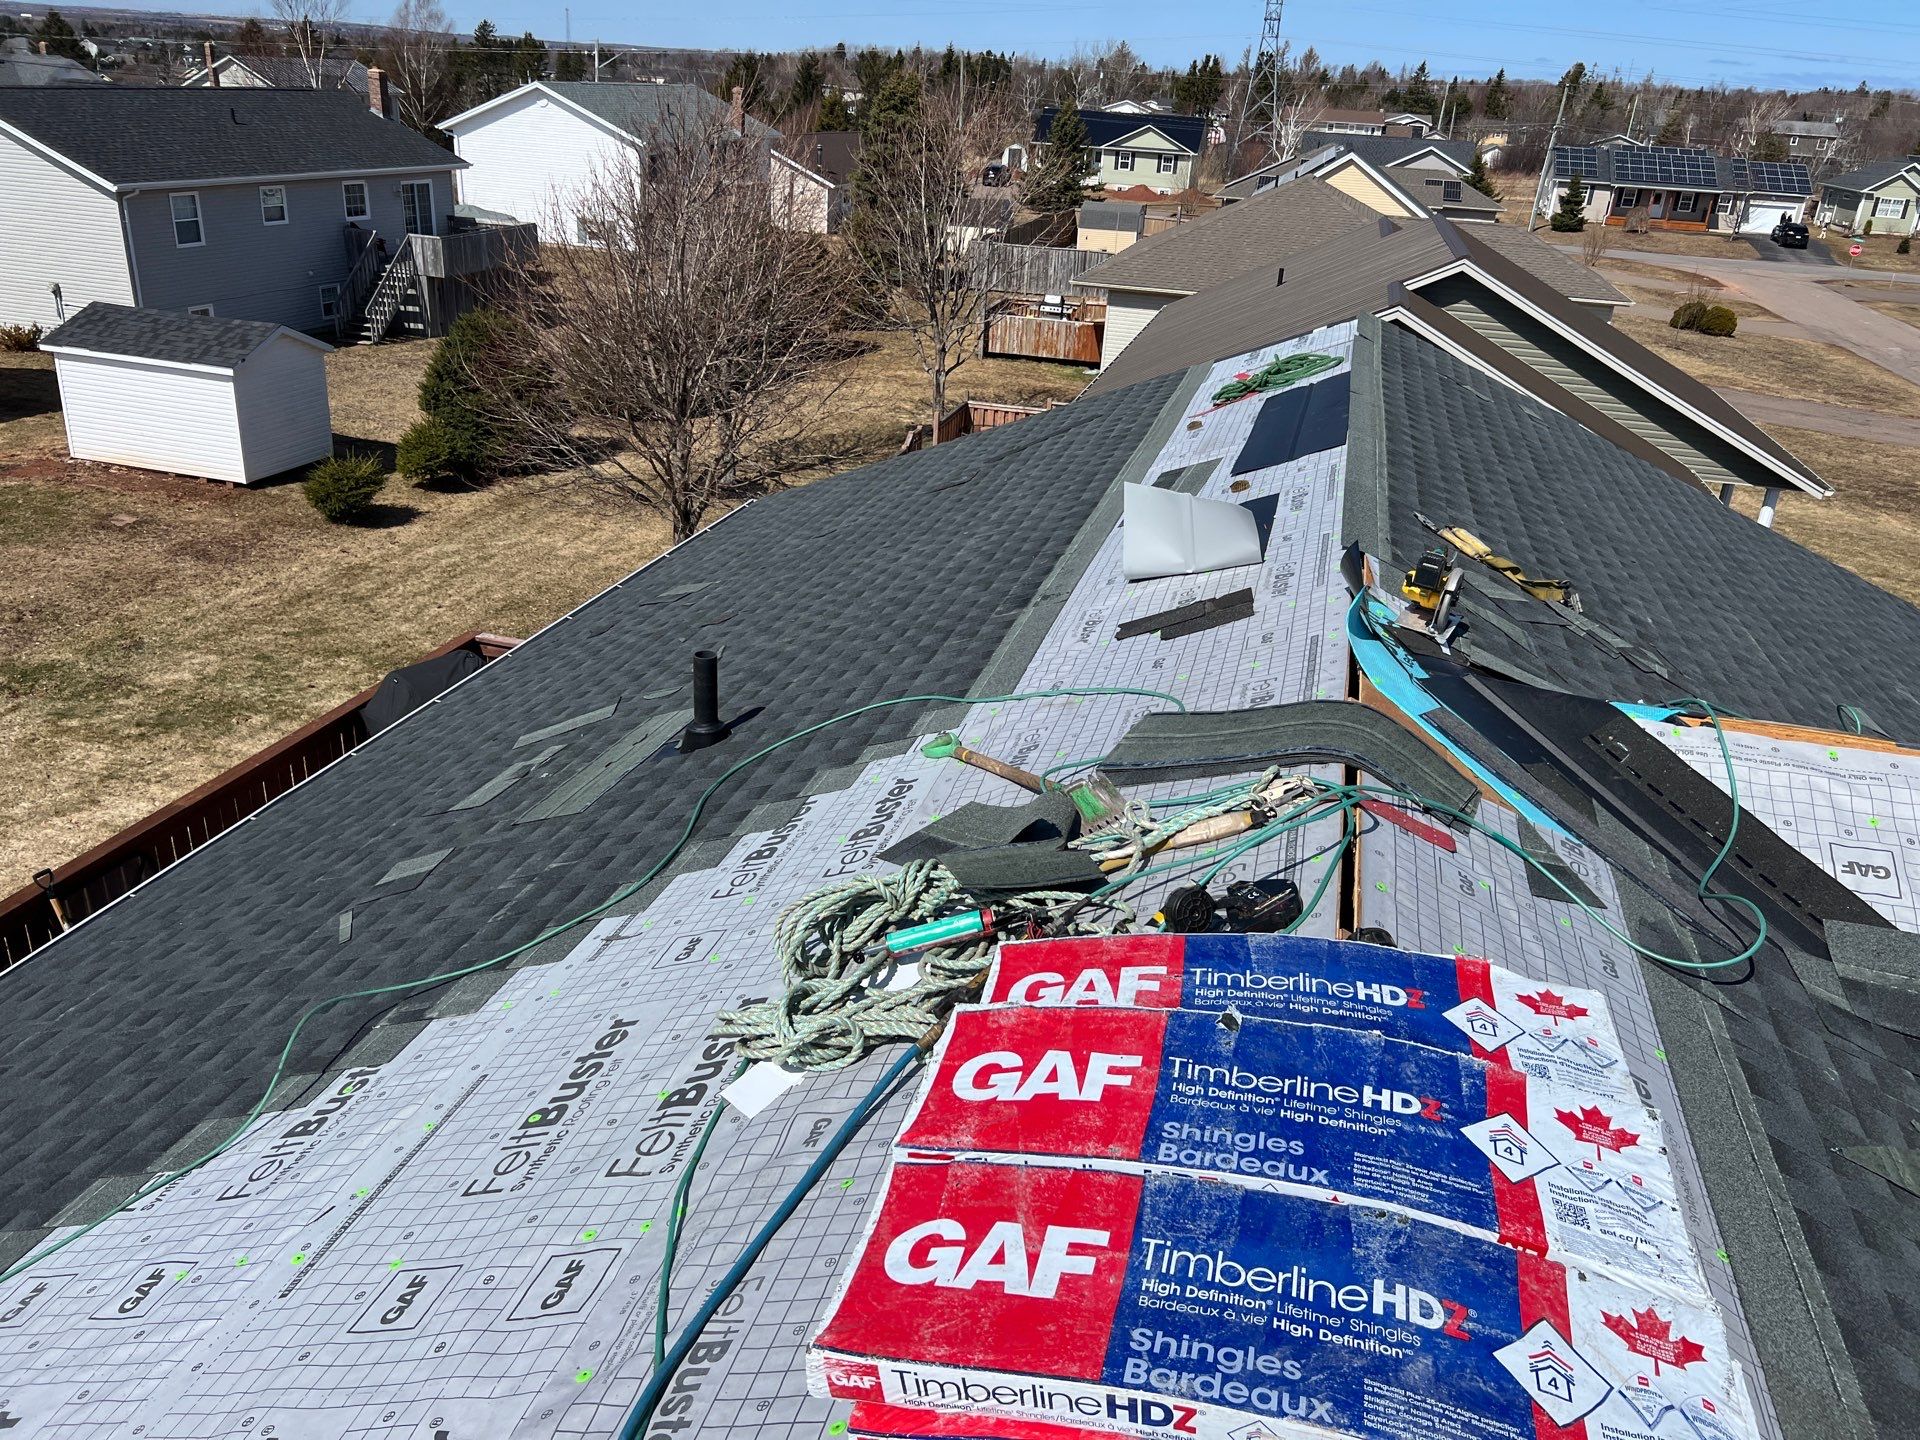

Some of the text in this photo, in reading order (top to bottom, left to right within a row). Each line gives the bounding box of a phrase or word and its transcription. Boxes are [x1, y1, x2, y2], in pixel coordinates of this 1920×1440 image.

[822, 778, 918, 878] FeltBuster
[841, 861, 892, 880] GAF
[1458, 870, 1475, 896] GAF
[674, 936, 703, 961] GAF
[1602, 953, 1619, 979] GAF
[1007, 966, 1167, 1006] GAF
[1195, 988, 1224, 997] High
[1343, 1001, 1393, 1016] Shingles
[1195, 998, 1252, 1006] Bardeaux
[1290, 1003, 1318, 1012] High
[604, 997, 769, 1178] FeltBustr
[952, 1050, 1143, 1102] GAF
[1170, 1094, 1236, 1110] Bardeaux
[1280, 1109, 1314, 1122] High
[1172, 1082, 1204, 1095] High
[1344, 1108, 1402, 1127] Shingles
[216, 1064, 381, 1201] FeltBust
[510, 1129, 569, 1192] Synthetic
[562, 1080, 611, 1127] Roofing
[659, 1109, 713, 1174] Synthetic
[802, 1118, 832, 1148] GAF
[1161, 1122, 1304, 1155] Shingles
[1503, 1144, 1514, 1158] 4
[1158, 1142, 1329, 1186] Bardeaux
[1548, 1181, 1597, 1199] Installation
[1549, 1188, 1599, 1204] Instructions
[883, 1218, 1110, 1299] GAF
[0, 1281, 49, 1322] GAF
[118, 1267, 168, 1314] GAF
[380, 1274, 429, 1324] GAF
[540, 1259, 585, 1310] GAF
[1138, 1295, 1220, 1317] Bardeaux
[1224, 1307, 1236, 1320] à
[1272, 1317, 1313, 1338] High
[1141, 1278, 1181, 1297] High
[1350, 1319, 1421, 1346] Shingles
[1129, 1328, 1302, 1380] Shingles
[830, 1371, 880, 1389] GAF
[1123, 1357, 1334, 1424] Bardeaux
[1364, 1378, 1404, 1395] Stainguard
[1426, 1397, 1455, 1411] 25-year
[1456, 1408, 1479, 1420] Algae
[1374, 1387, 1407, 1401] Protection
[1408, 1398, 1432, 1409] Contre
[1548, 1377, 1560, 1390] 4
[904, 1399, 926, 1407] High
[1135, 1428, 1159, 1437] High
[1364, 1401, 1384, 1413] Zone
[1385, 1407, 1396, 1415] de
[1410, 1408, 1439, 1422] Nailing
[1442, 1418, 1461, 1429] Area
[1601, 1423, 1656, 1440] Installation
